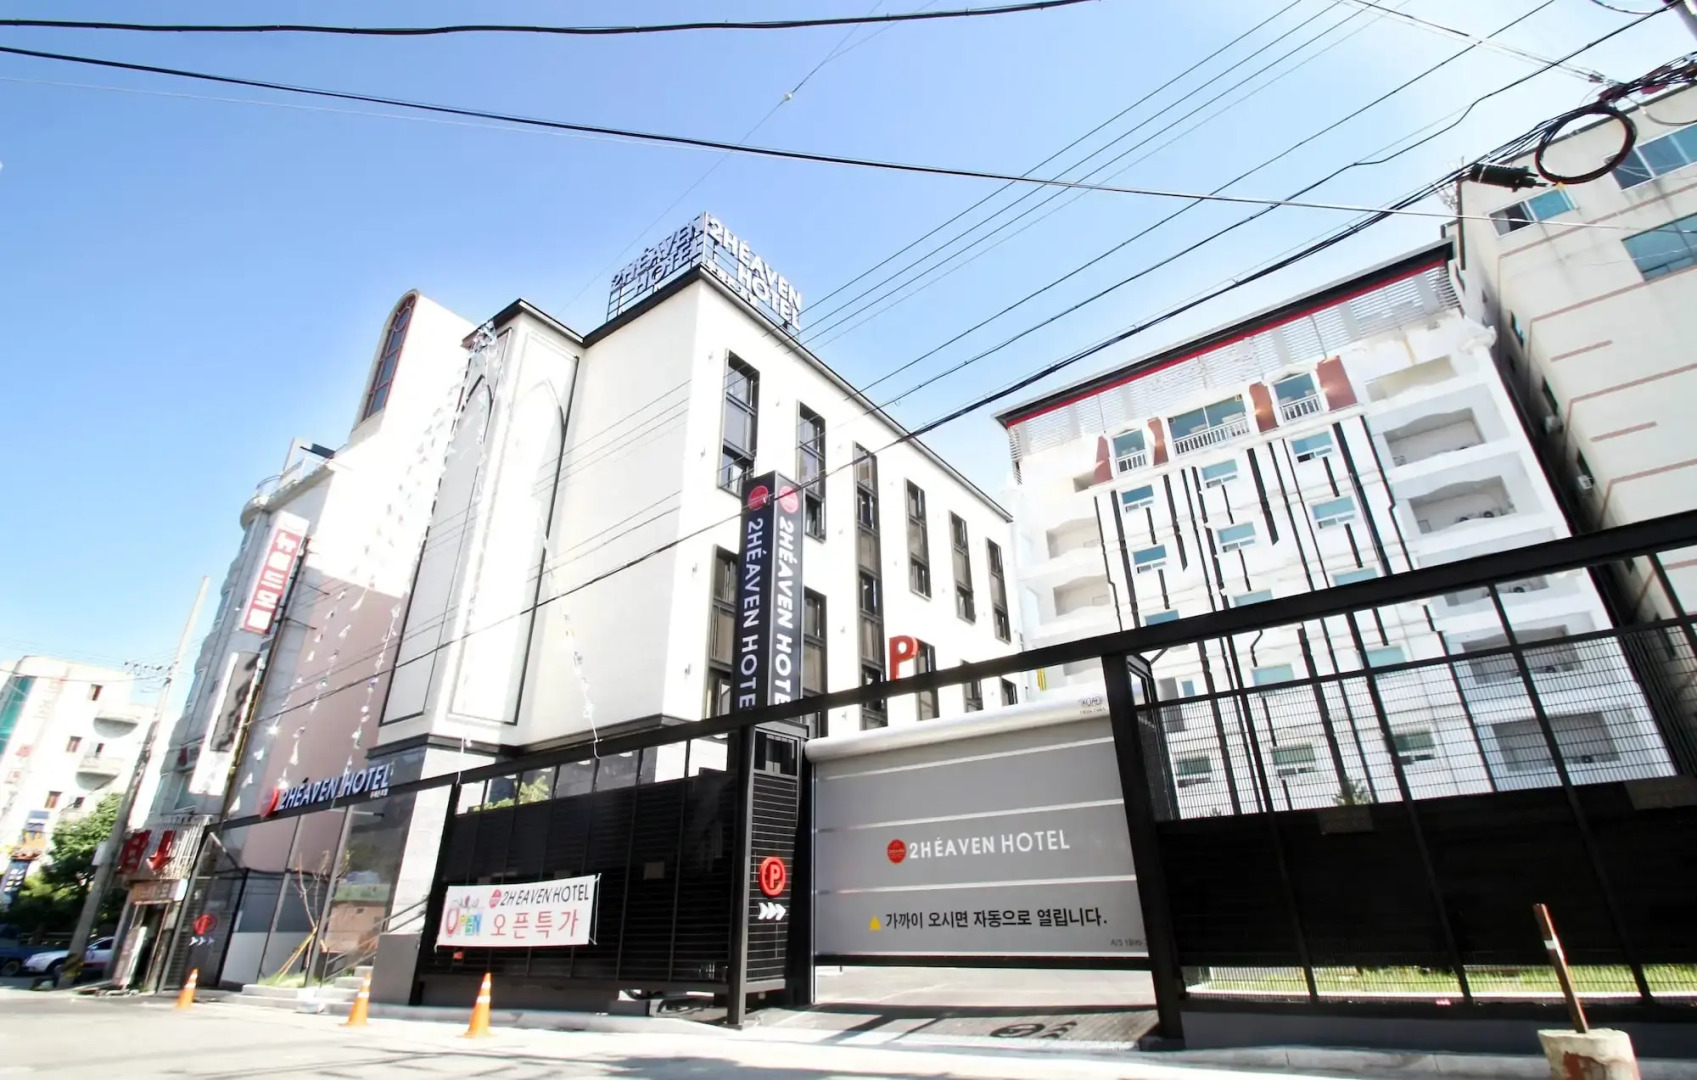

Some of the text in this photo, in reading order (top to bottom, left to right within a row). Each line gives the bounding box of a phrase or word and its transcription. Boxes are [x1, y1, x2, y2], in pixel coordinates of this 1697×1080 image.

[737, 258, 801, 331] HOTEL
[739, 634, 758, 709] HOTE
[775, 633, 793, 705] HOTE
[889, 635, 920, 681] P
[342, 764, 390, 795] HOTEL
[909, 829, 1070, 859] 2HÉAVEN HOTEL
[552, 883, 589, 904] HOTEL
[490, 909, 579, 939] 오픈특가
[885, 907, 1108, 930] 가까이 오시면 자동으로 열립니다.
